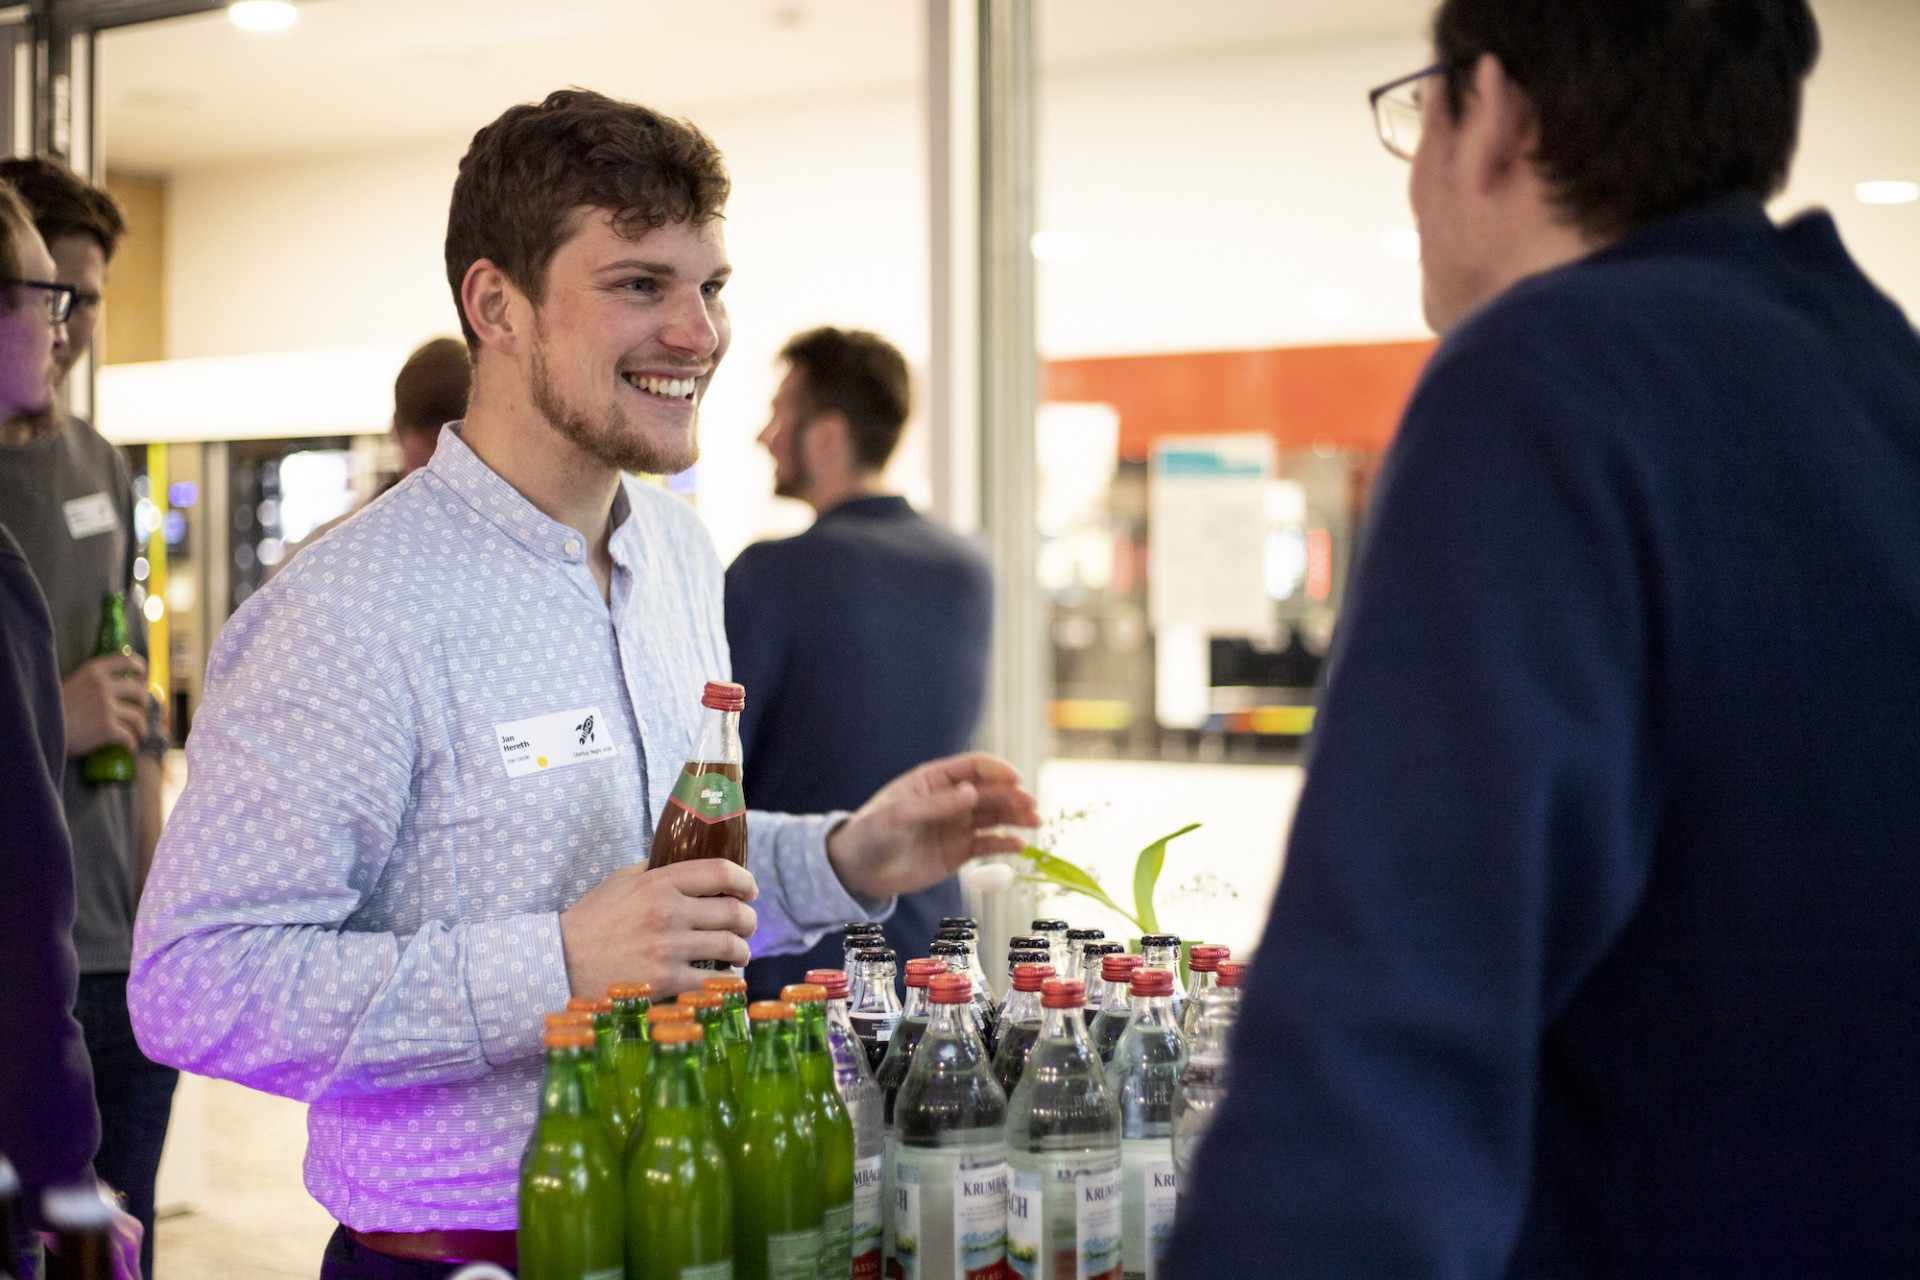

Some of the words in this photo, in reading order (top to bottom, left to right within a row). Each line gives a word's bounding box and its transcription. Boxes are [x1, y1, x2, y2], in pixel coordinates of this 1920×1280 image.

[501, 735, 515, 743] Jan
[503, 740, 530, 752] Hereth
[853, 1167, 882, 1185] MBACH
[963, 1175, 1007, 1197] KRUMBA
[854, 1260, 878, 1272] ASSIC
